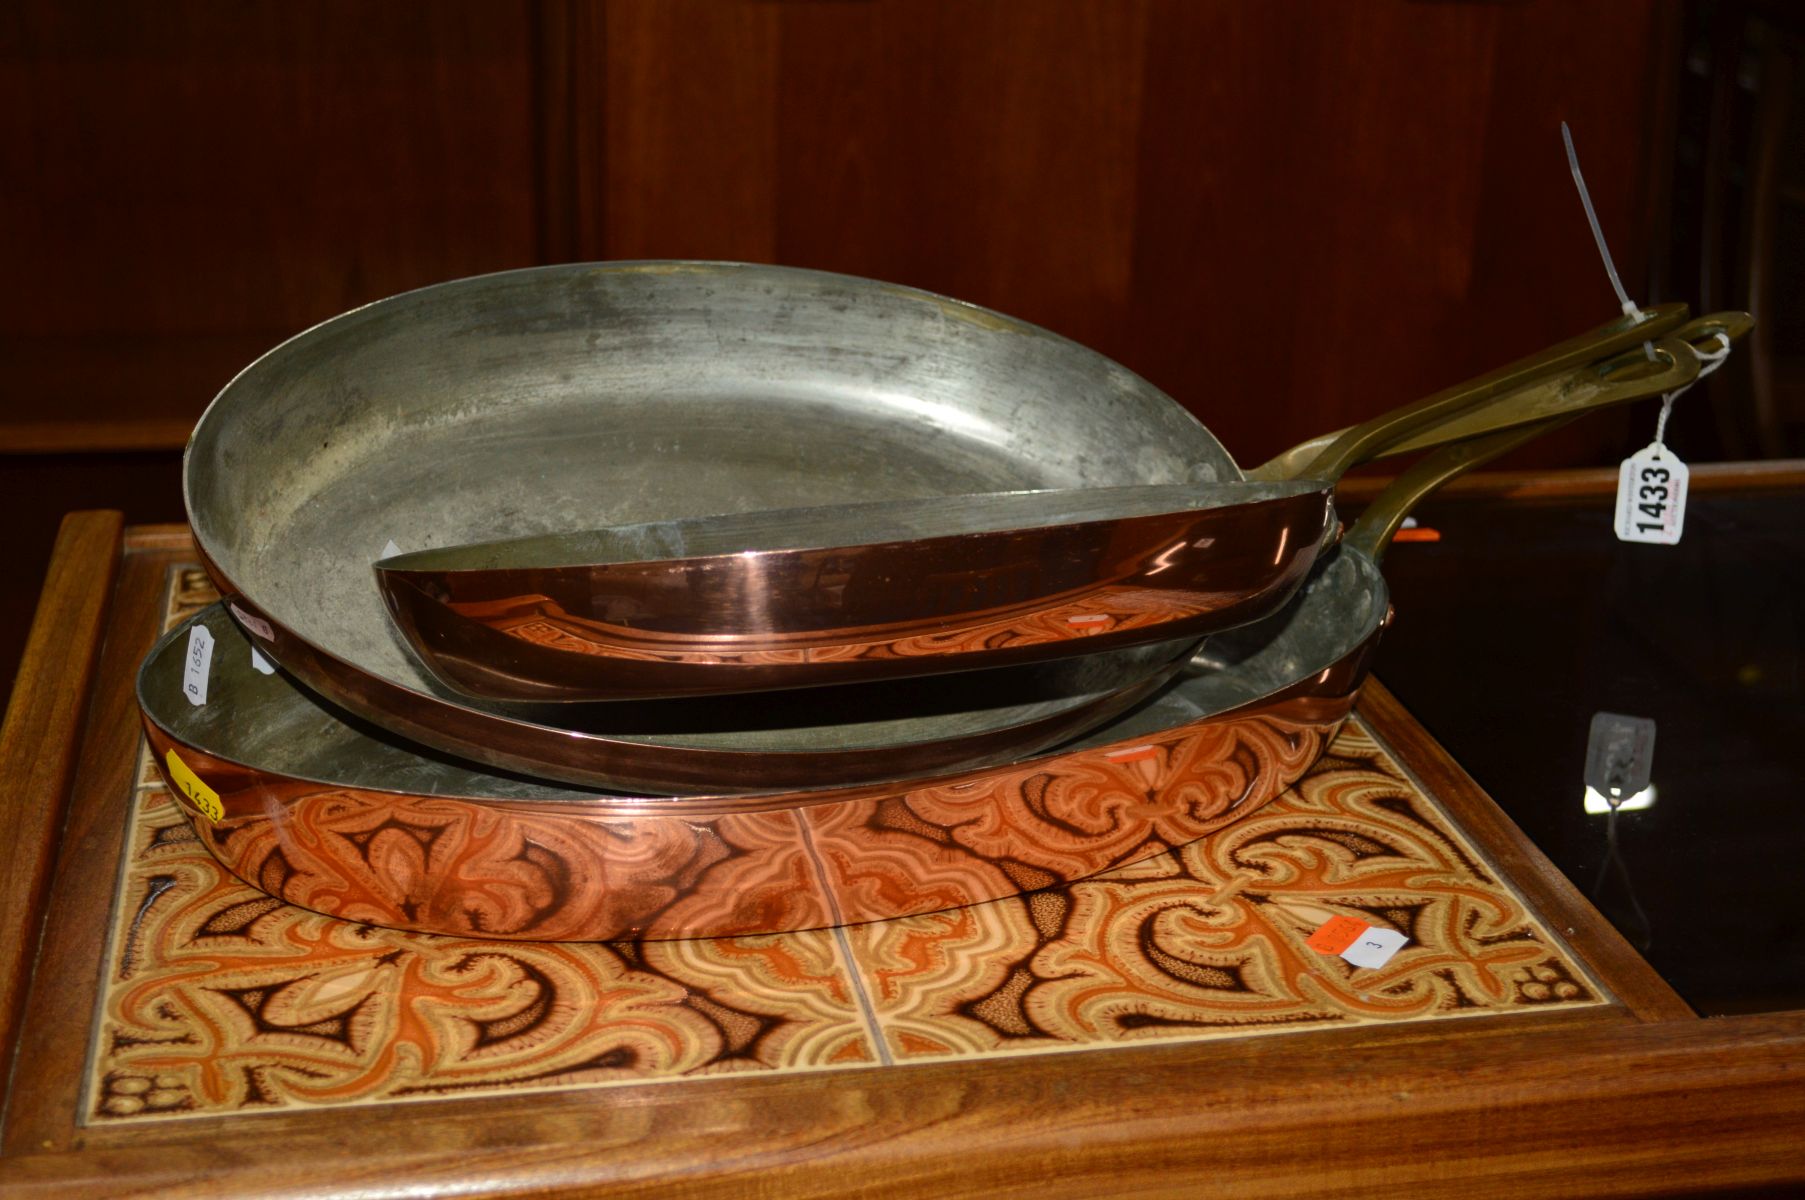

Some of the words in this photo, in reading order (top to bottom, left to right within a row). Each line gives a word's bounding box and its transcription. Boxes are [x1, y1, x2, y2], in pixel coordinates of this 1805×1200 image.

[1636, 468, 1670, 534] 1433
[191, 637, 205, 674] 1652
[188, 684, 199, 695] B
